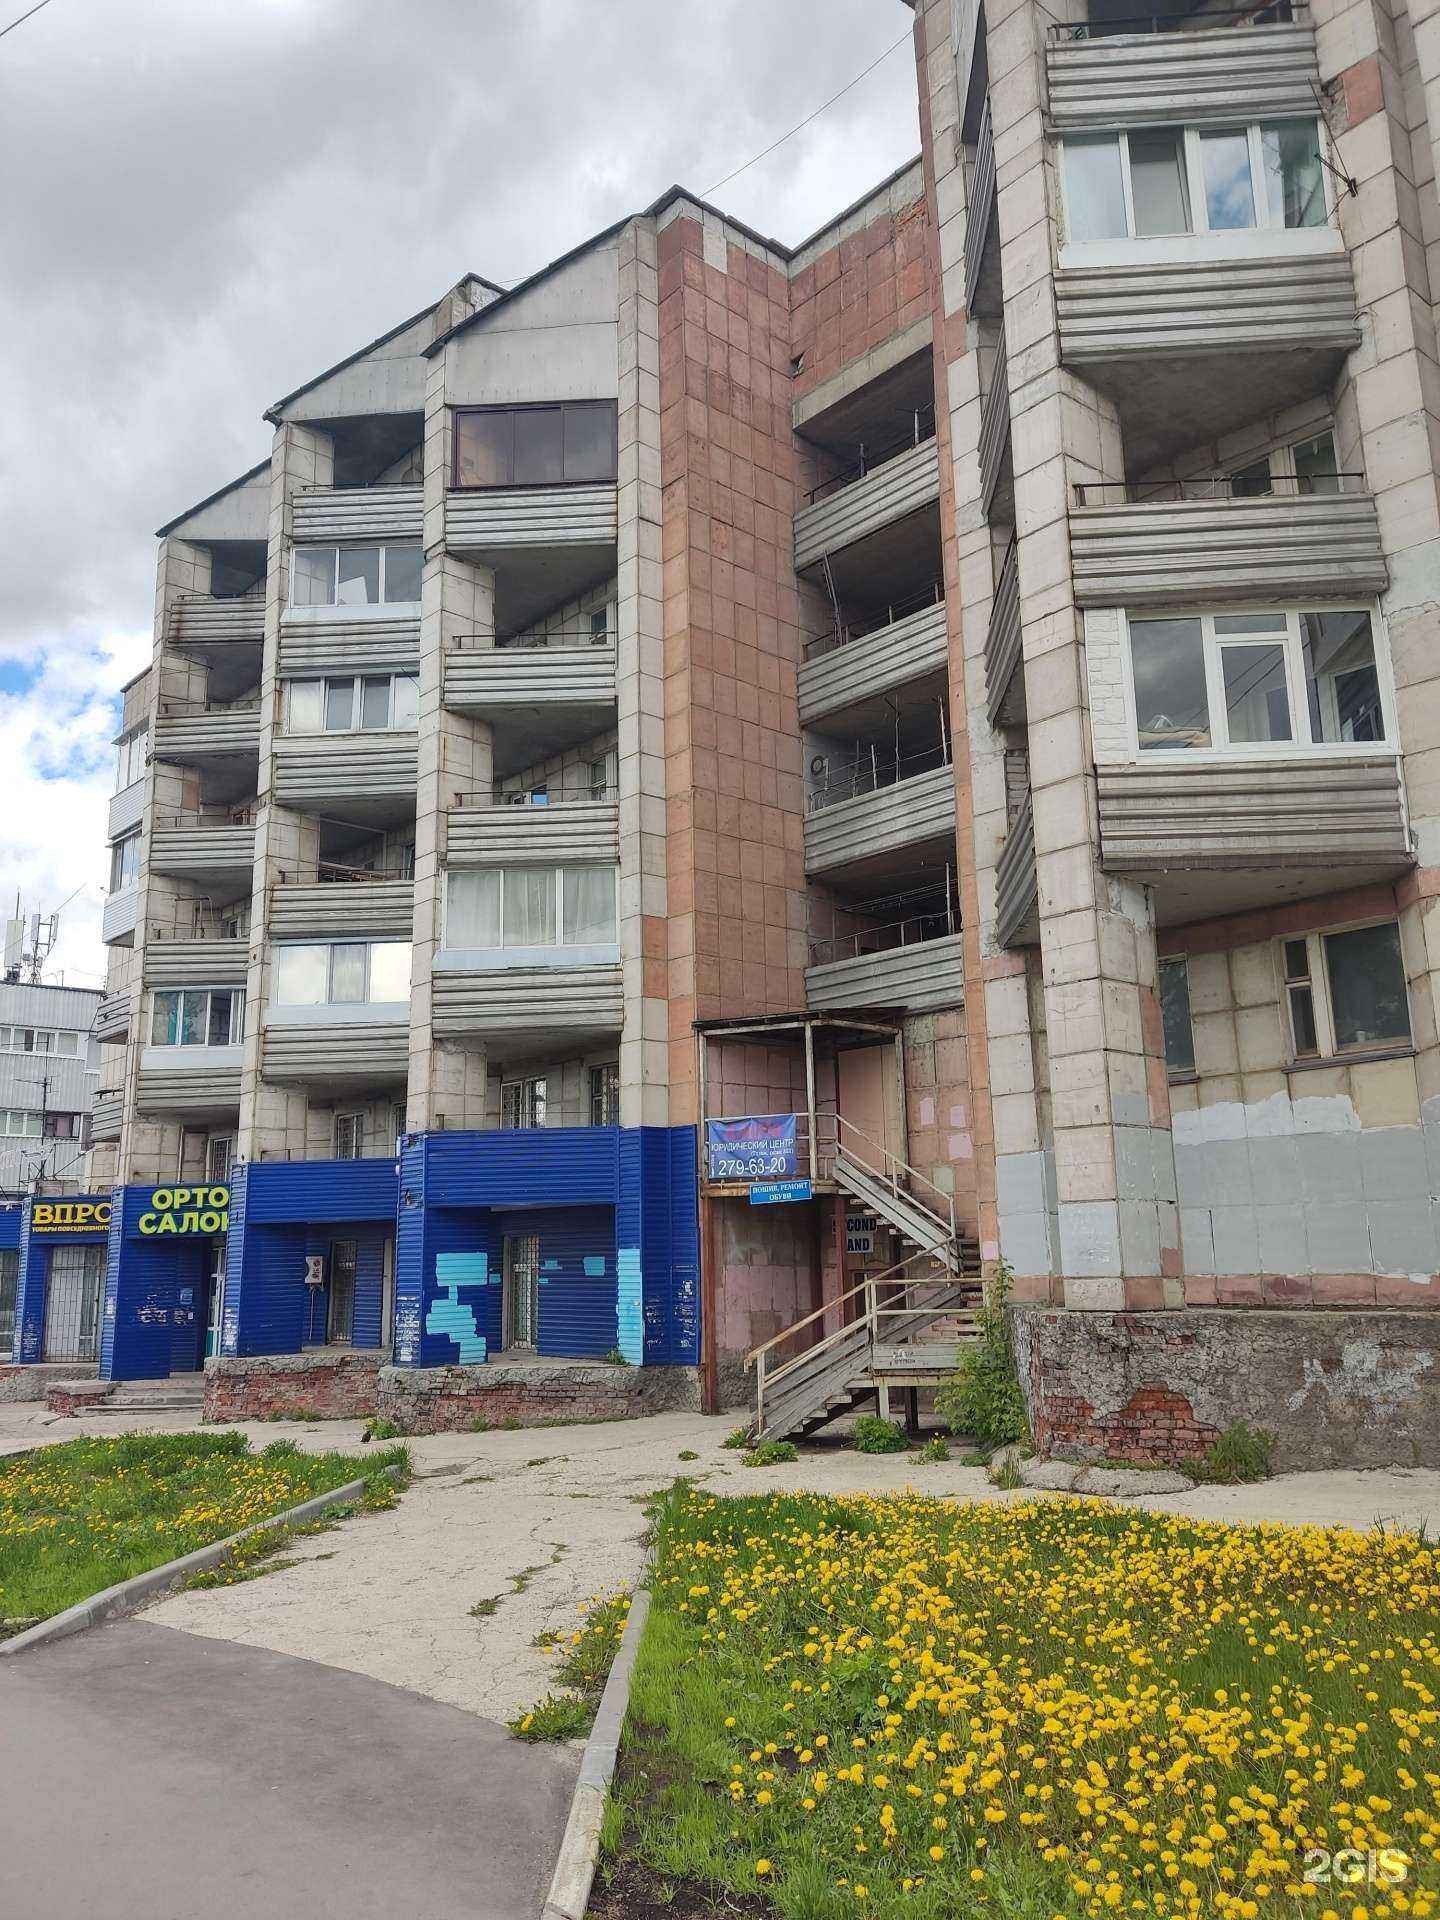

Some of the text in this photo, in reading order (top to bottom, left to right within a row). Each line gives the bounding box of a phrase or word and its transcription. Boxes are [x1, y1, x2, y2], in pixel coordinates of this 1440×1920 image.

[711, 1138, 794, 1152] ЮРИДИЧЕСКИЙ ЦЕНТР
[718, 1156, 786, 1176] 279-63-20
[780, 1182, 808, 1191] РЕМОНТ
[152, 1187, 229, 1210] ОРТО
